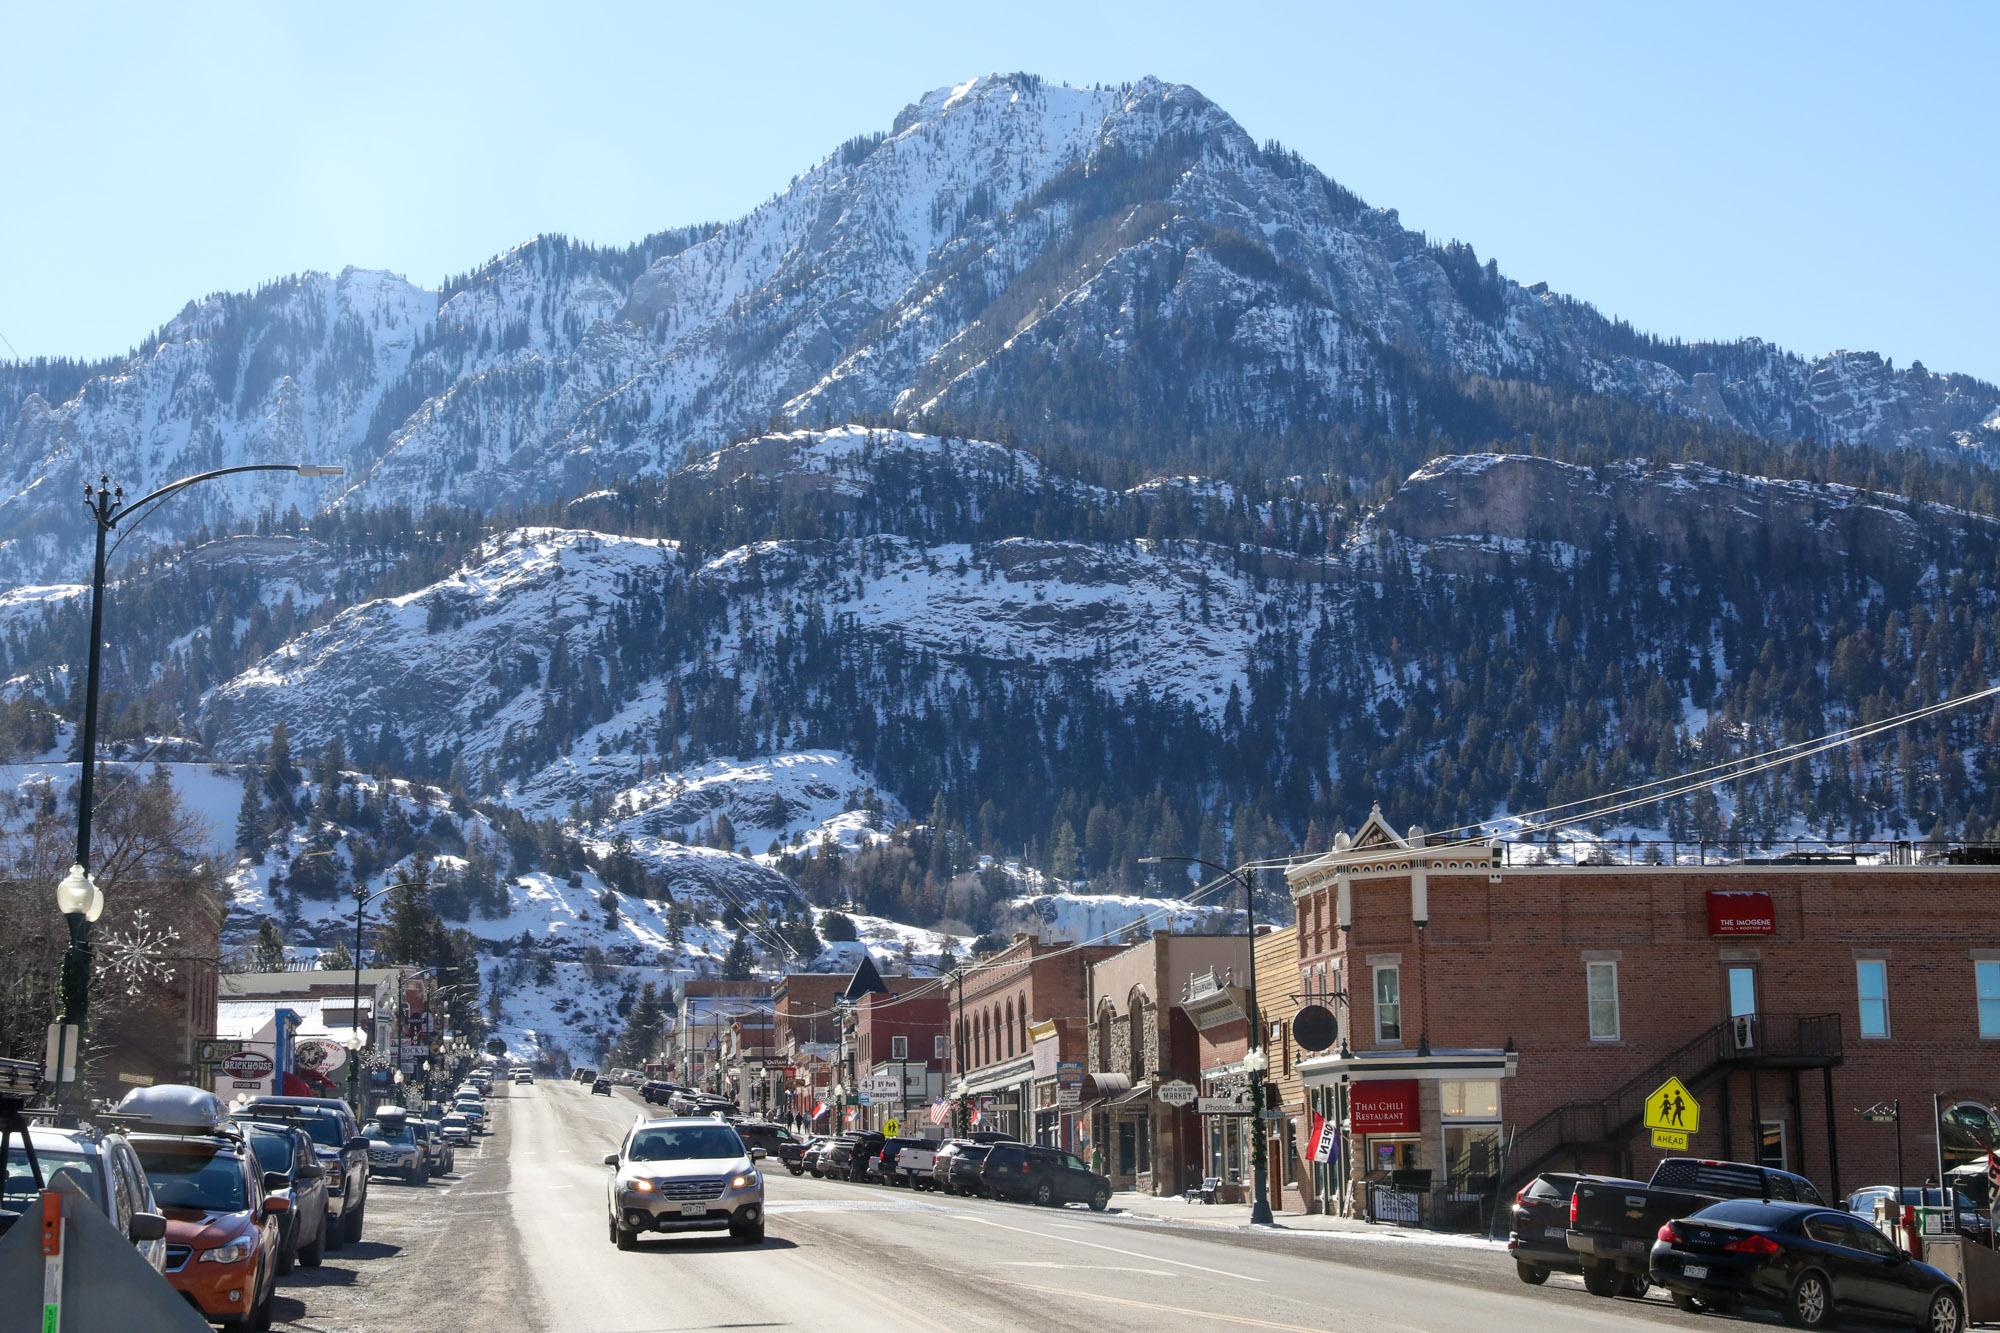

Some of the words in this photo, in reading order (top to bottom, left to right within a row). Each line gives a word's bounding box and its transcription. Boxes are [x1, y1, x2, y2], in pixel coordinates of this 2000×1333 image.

[224, 1060, 273, 1071] BRICKHOUSE
[1163, 1092, 1192, 1100] MARKET
[1205, 1103, 1231, 1111] Photos
[1354, 1102, 1376, 1111] THAI
[1379, 1101, 1404, 1111] CHILI
[1355, 1112, 1404, 1120] RESTAURANT
[1657, 1135, 1684, 1145] AHEAD
